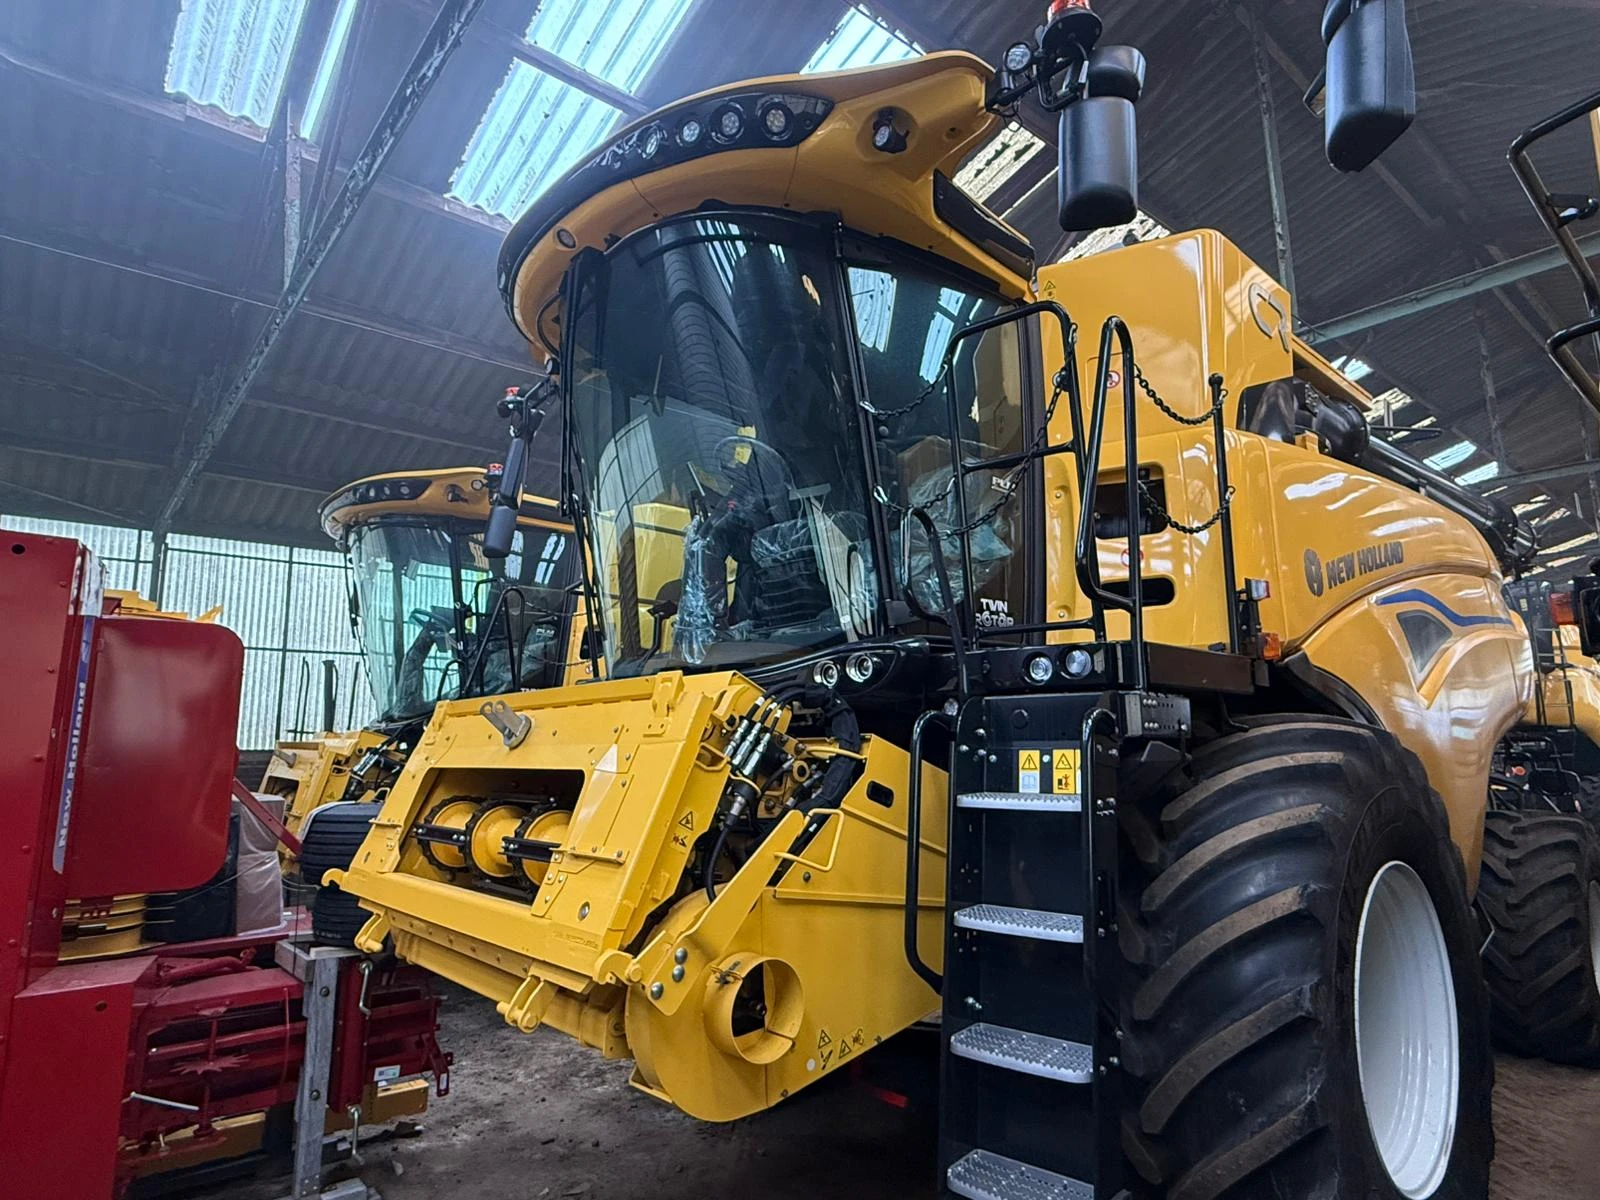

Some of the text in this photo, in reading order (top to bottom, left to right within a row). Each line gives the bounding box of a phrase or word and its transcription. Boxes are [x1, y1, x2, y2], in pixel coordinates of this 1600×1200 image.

[1326, 541, 1404, 590] NEW HOLLAND
[980, 598, 1008, 613] TWIN
[58, 681, 86, 848] New Holland
